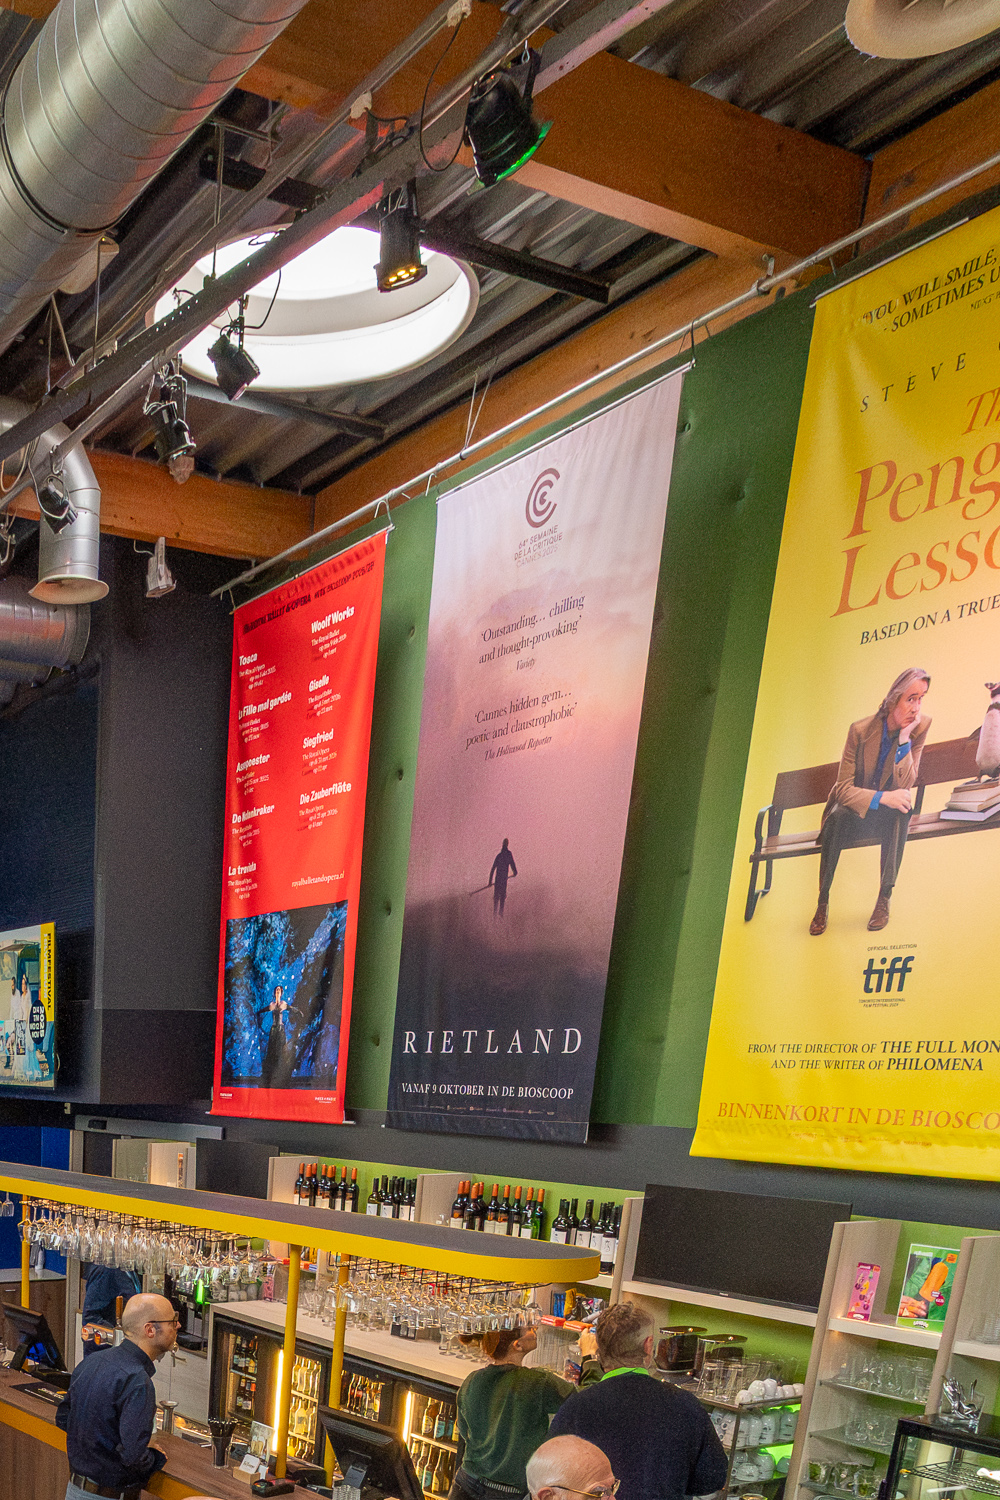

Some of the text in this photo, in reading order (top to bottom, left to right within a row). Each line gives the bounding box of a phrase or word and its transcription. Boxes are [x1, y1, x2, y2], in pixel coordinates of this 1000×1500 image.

[902, 276, 940, 306] WILL
[944, 248, 997, 286] SMILE,
[891, 273, 986, 332] SOMETIMES
[860, 352, 966, 413] STEVE
[842, 442, 1000, 540] Peng
[514, 531, 563, 560] DE LA CRITIQUE
[530, 524, 558, 544] SEMAINE
[549, 595, 585, 617] chilling
[311, 605, 355, 633] Woolf Works
[860, 593, 1000, 645] BASED ON A TRUE
[239, 652, 258, 667] Tosca
[479, 646, 495, 664] and
[308, 674, 330, 692] Giselle
[243, 703, 257, 717] Fille
[257, 698, 269, 713] mal
[269, 690, 292, 711] gardée
[509, 695, 539, 714] hidden
[302, 728, 334, 749] Siegfried
[465, 729, 491, 751] poetic
[492, 722, 508, 739] and
[300, 781, 352, 805] Die Zauberflöte
[232, 813, 242, 824] De
[228, 865, 237, 876] La
[863, 956, 915, 993] tiff
[402, 1028, 582, 1054] RIETLAND
[747, 1044, 776, 1053] FROM
[779, 1043, 802, 1053] THE
[804, 1043, 859, 1054] DIRECTOR
[861, 1043, 877, 1053] OF
[880, 1041, 912, 1053] THE
[915, 1040, 956, 1053] FULL
[770, 1057, 984, 1071] AND THE WRITER OF PHILOMENA
[402, 1083, 574, 1099] VANAF 9 OKTOBER IN DE BIOSCOOP
[717, 1102, 844, 1123] BINNENKORT
[847, 1107, 871, 1124] IN
[875, 1108, 906, 1127] DE
